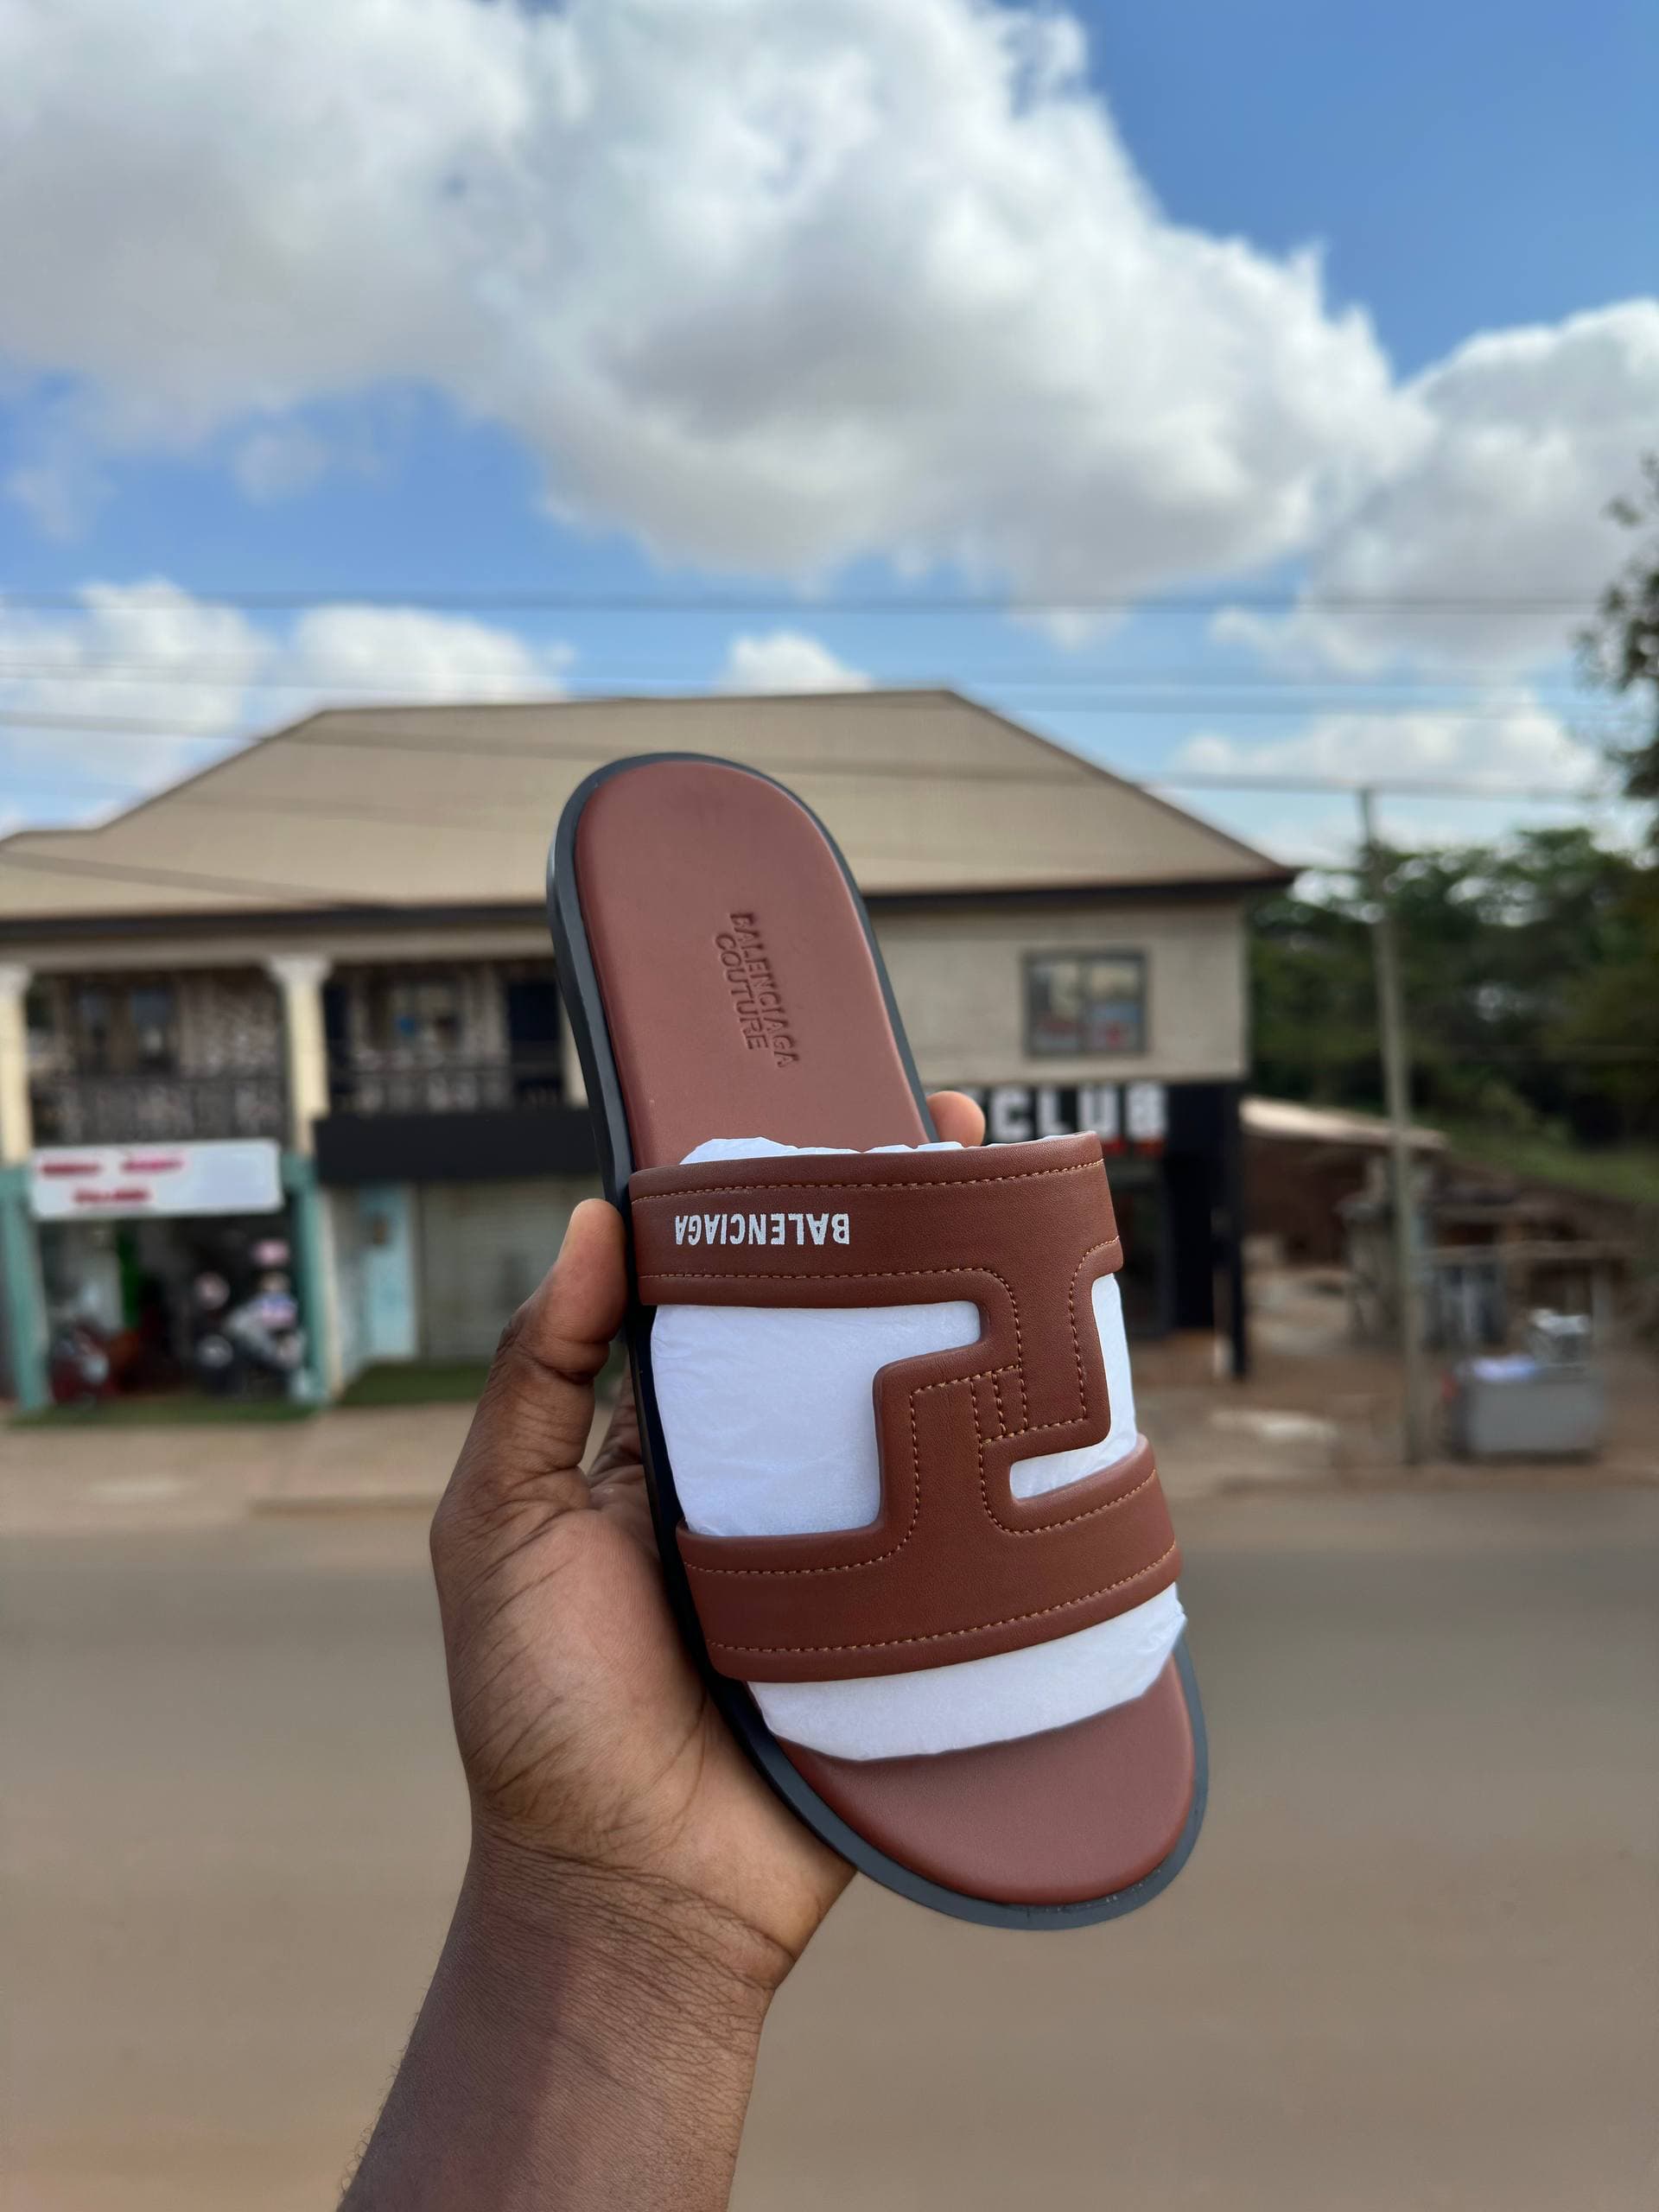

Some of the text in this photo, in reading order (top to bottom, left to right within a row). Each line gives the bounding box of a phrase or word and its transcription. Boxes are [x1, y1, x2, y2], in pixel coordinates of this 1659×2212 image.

[715, 933, 768, 1050] COUTURE
[730, 912, 799, 1068] BALENCIAGA
[675, 1213, 850, 1245] BALENCIAGA
